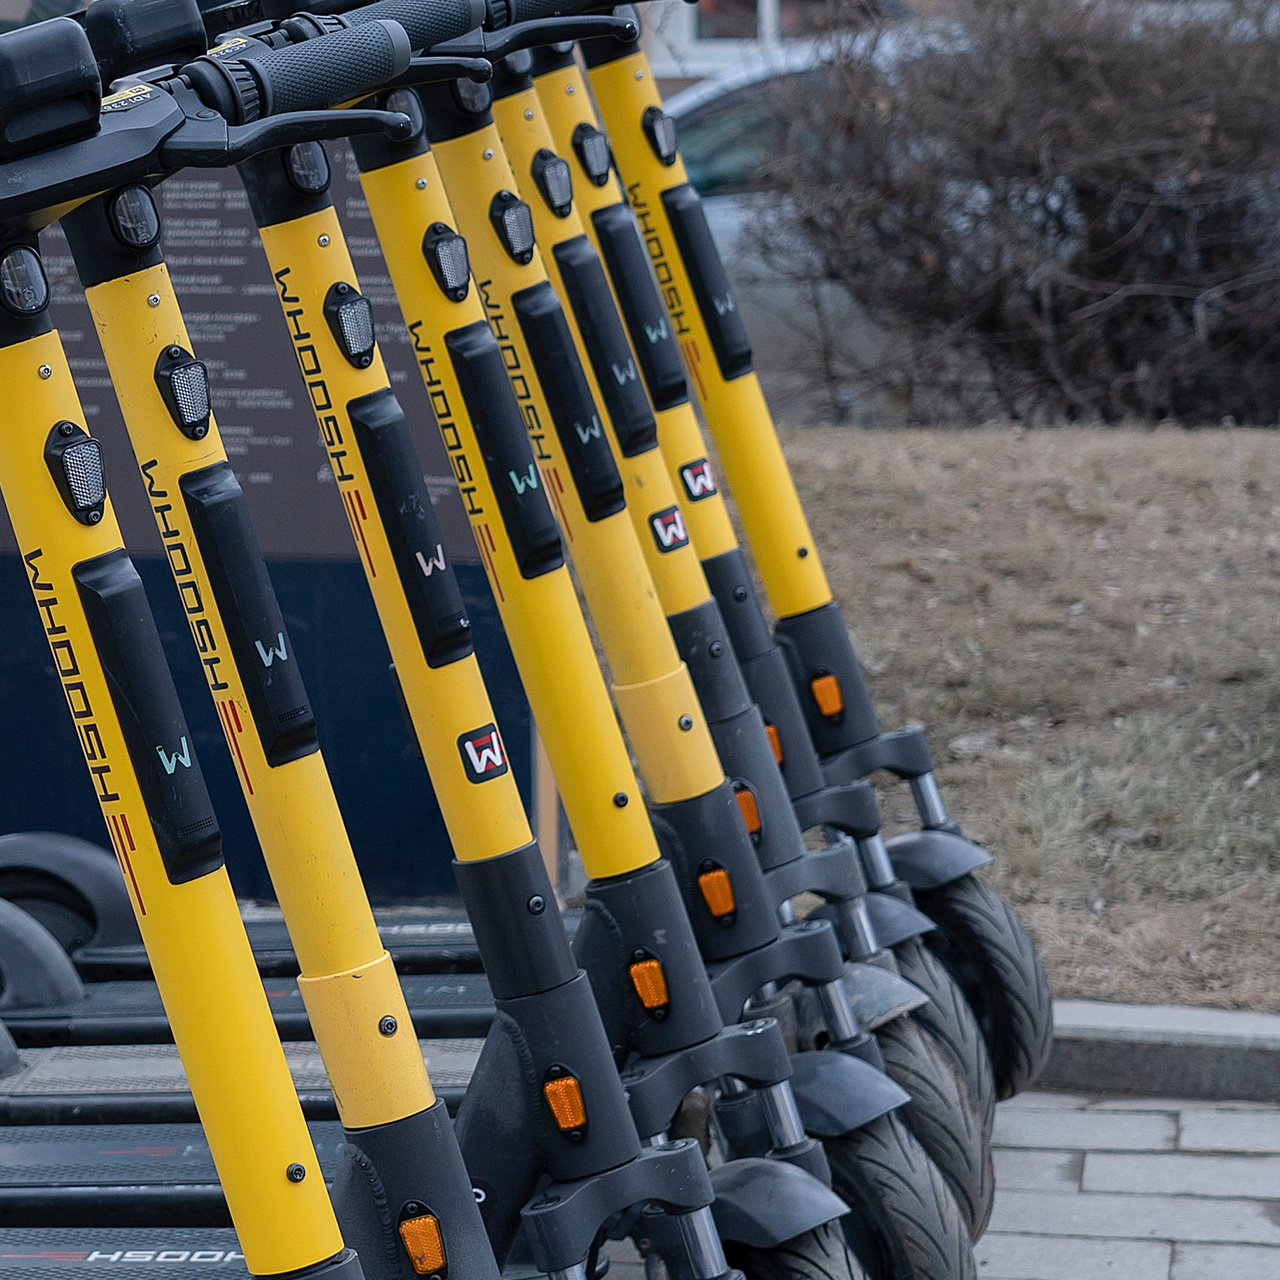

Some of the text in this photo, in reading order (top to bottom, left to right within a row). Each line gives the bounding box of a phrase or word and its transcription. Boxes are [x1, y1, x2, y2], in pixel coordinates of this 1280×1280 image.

[629, 183, 690, 335] WHOOSH
[275, 267, 354, 483] WHOOSH
[407, 320, 483, 515] WHOOSH
[478, 279, 551, 461] WHOOSH
[23, 548, 119, 803] WHOOSH
[141, 458, 228, 692] WHOOSH
